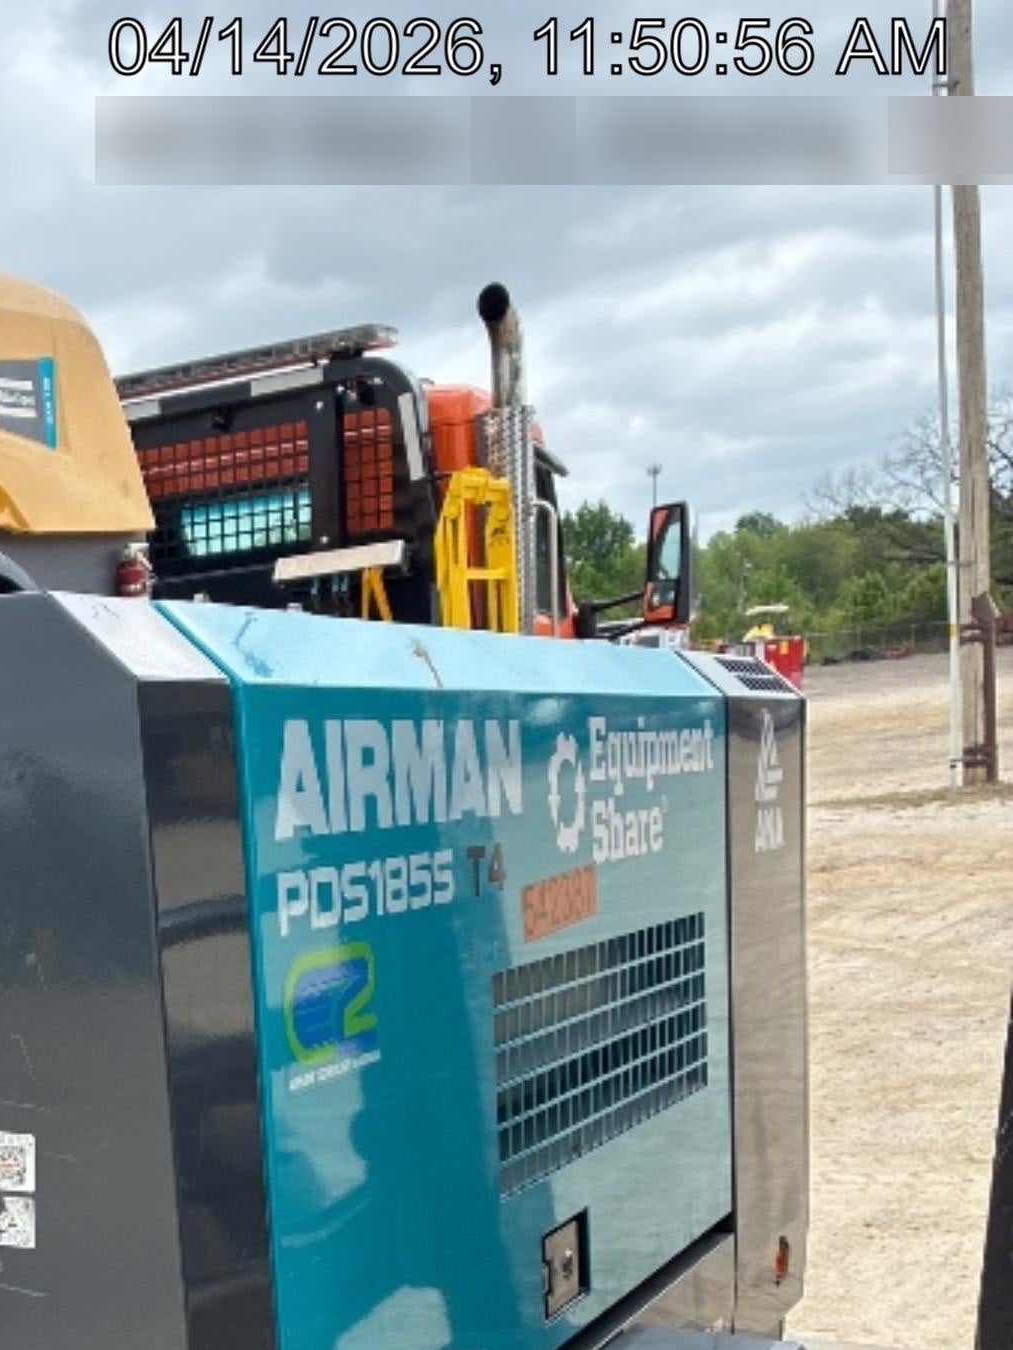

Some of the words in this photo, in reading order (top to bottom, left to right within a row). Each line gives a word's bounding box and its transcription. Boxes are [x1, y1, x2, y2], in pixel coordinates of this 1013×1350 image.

[274, 718, 524, 841] AIRMAN
[588, 716, 715, 796] Equipment
[592, 797, 664, 865] Share
[466, 842, 506, 898] T4
